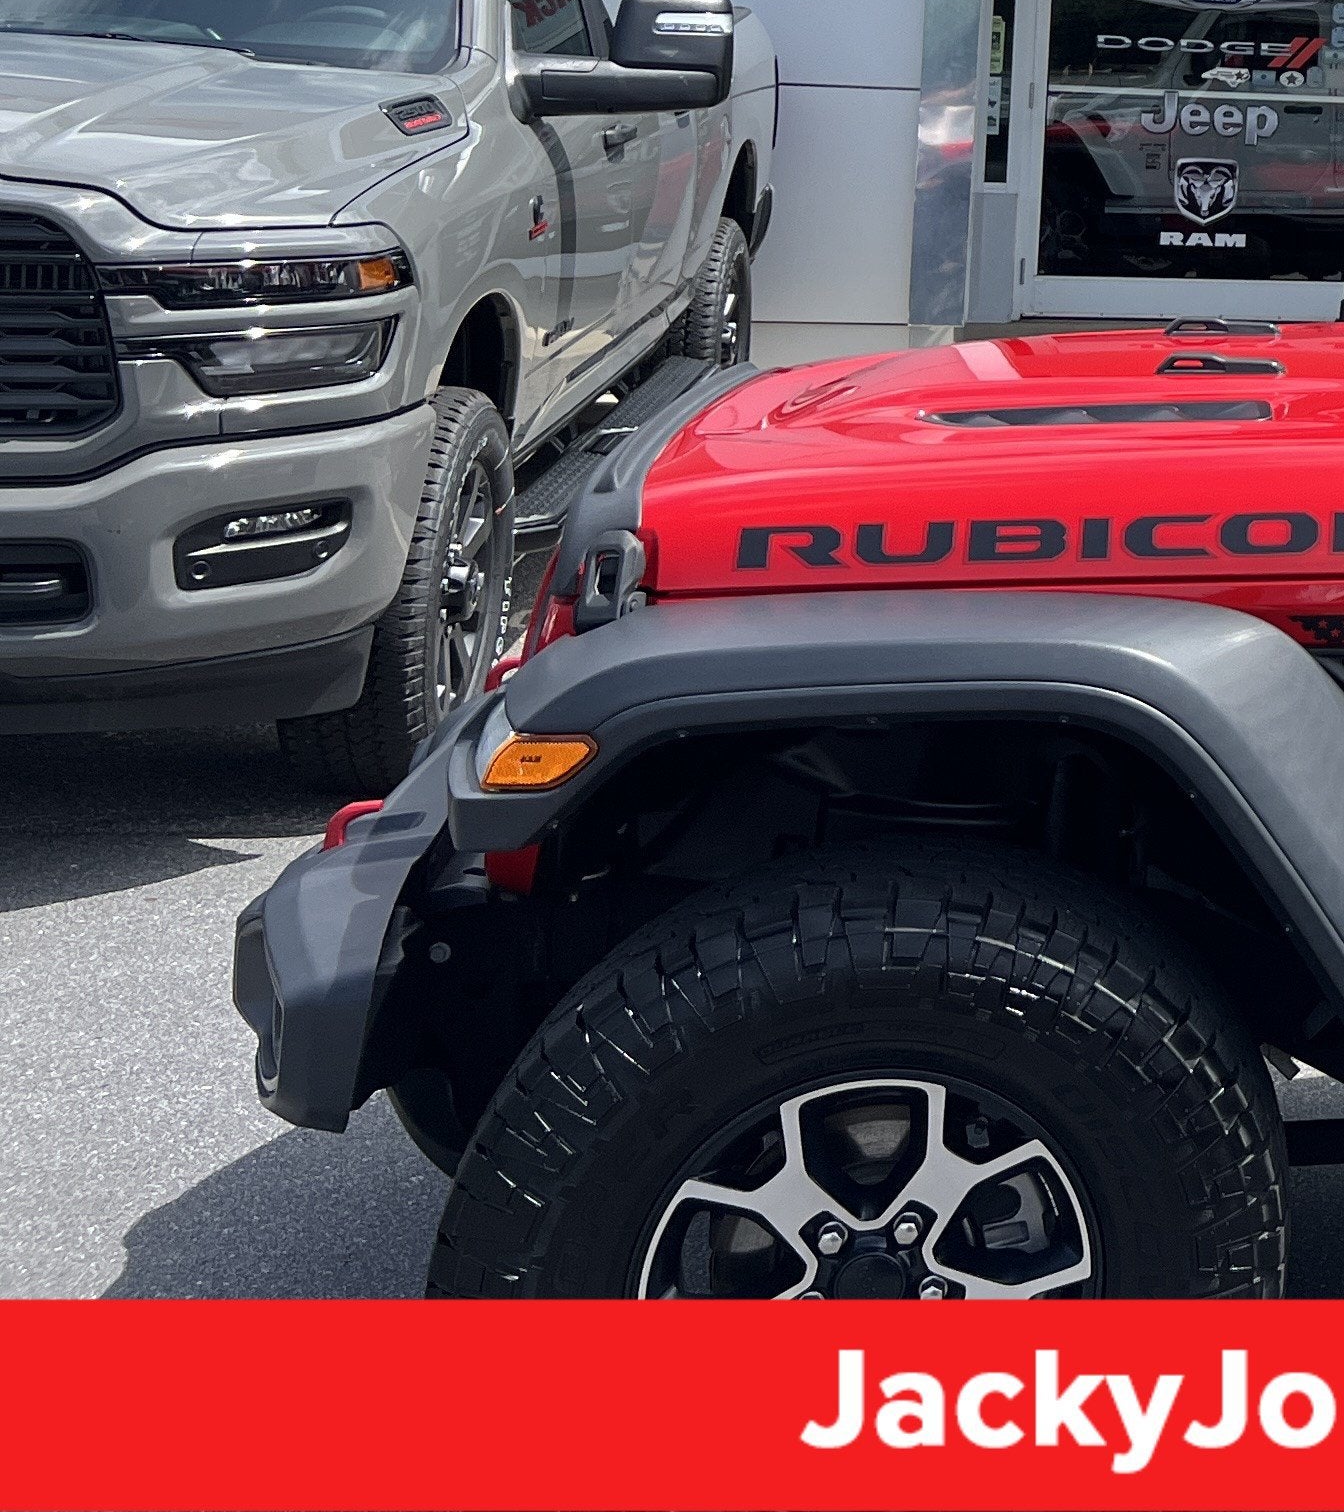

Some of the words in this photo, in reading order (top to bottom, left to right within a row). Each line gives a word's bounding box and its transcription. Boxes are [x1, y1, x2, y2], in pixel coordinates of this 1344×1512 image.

[1096, 34, 1294, 57] DODGE
[1140, 90, 1280, 147] Jeep
[1158, 231, 1247, 248] RAM
